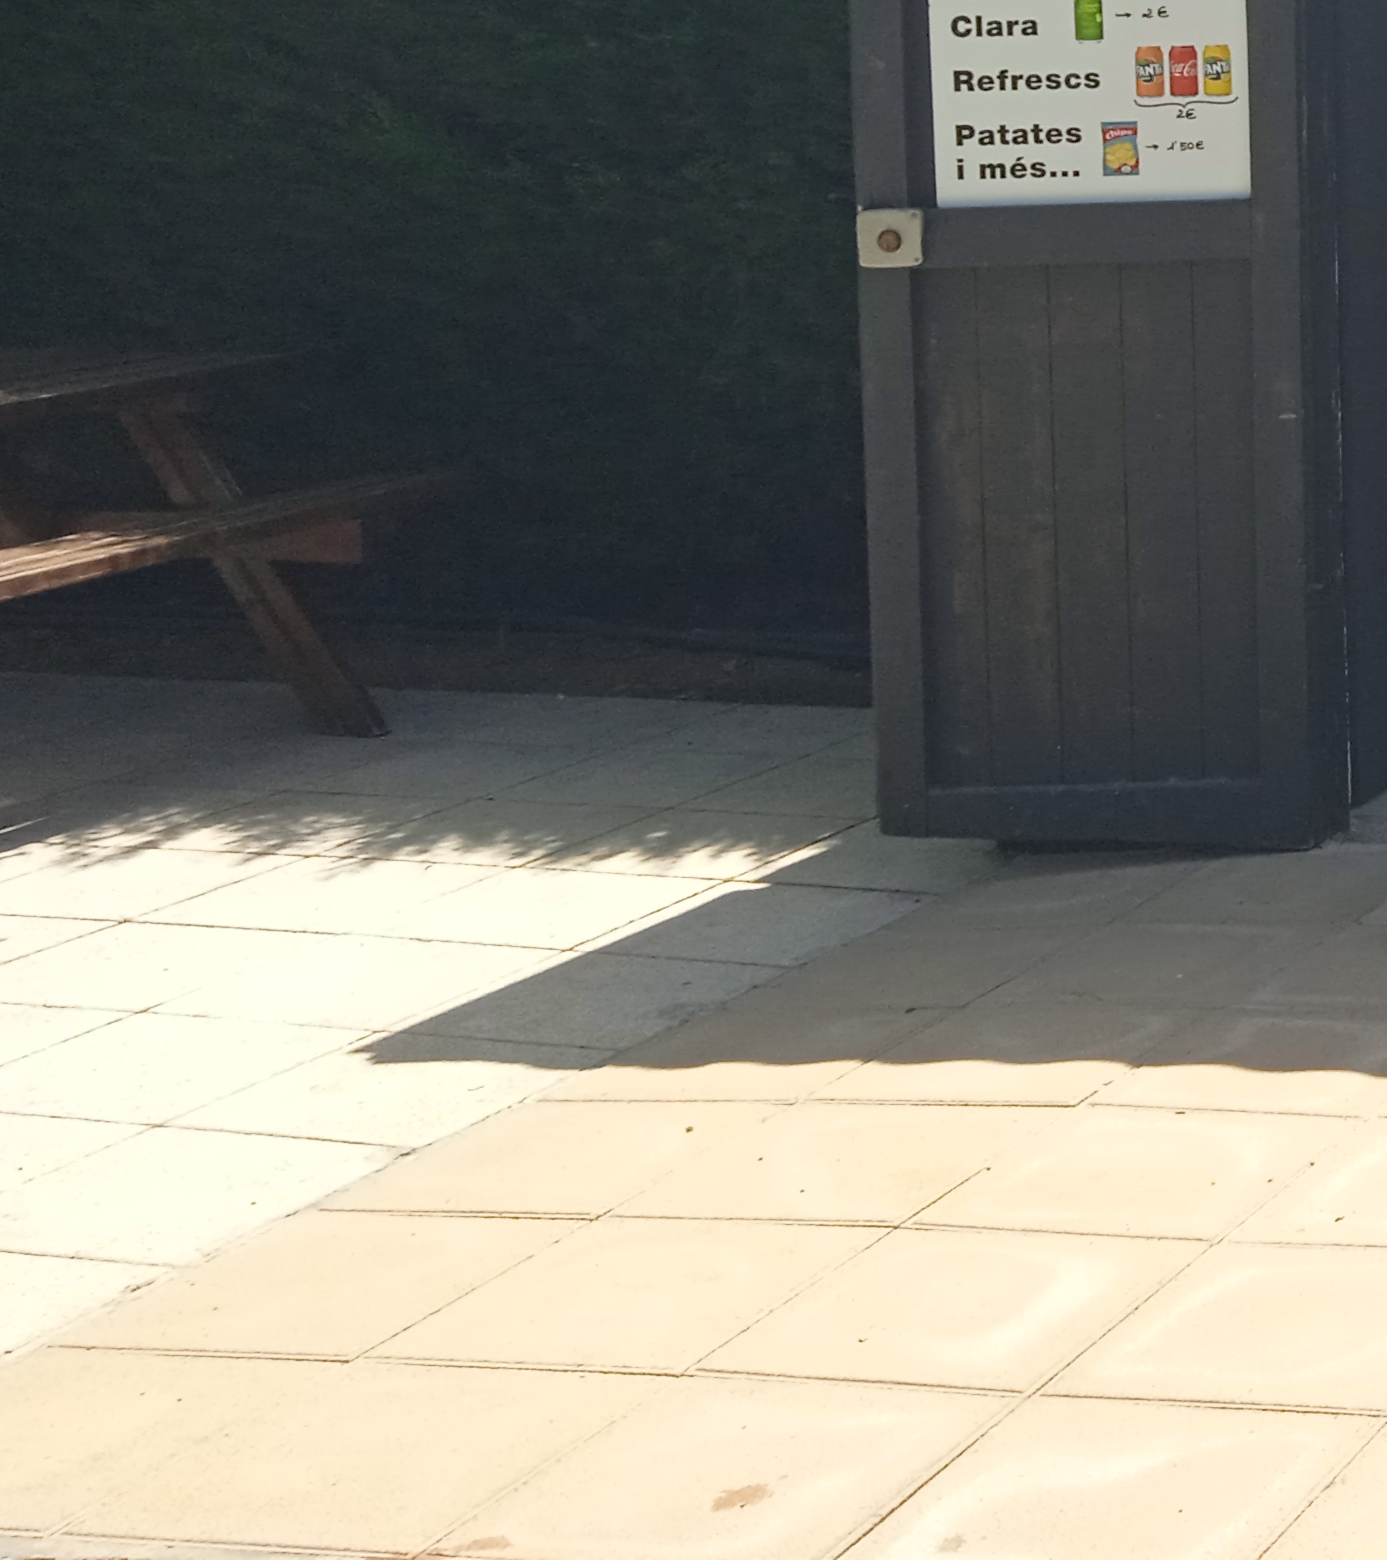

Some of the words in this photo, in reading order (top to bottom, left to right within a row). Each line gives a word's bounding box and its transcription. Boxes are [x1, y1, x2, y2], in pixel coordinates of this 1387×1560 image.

[950, 14, 1039, 38] Clara
[952, 69, 1101, 93] Refrescs
[954, 123, 1083, 147] Patates
[956, 158, 965, 181] i
[979, 155, 1081, 180] més...
